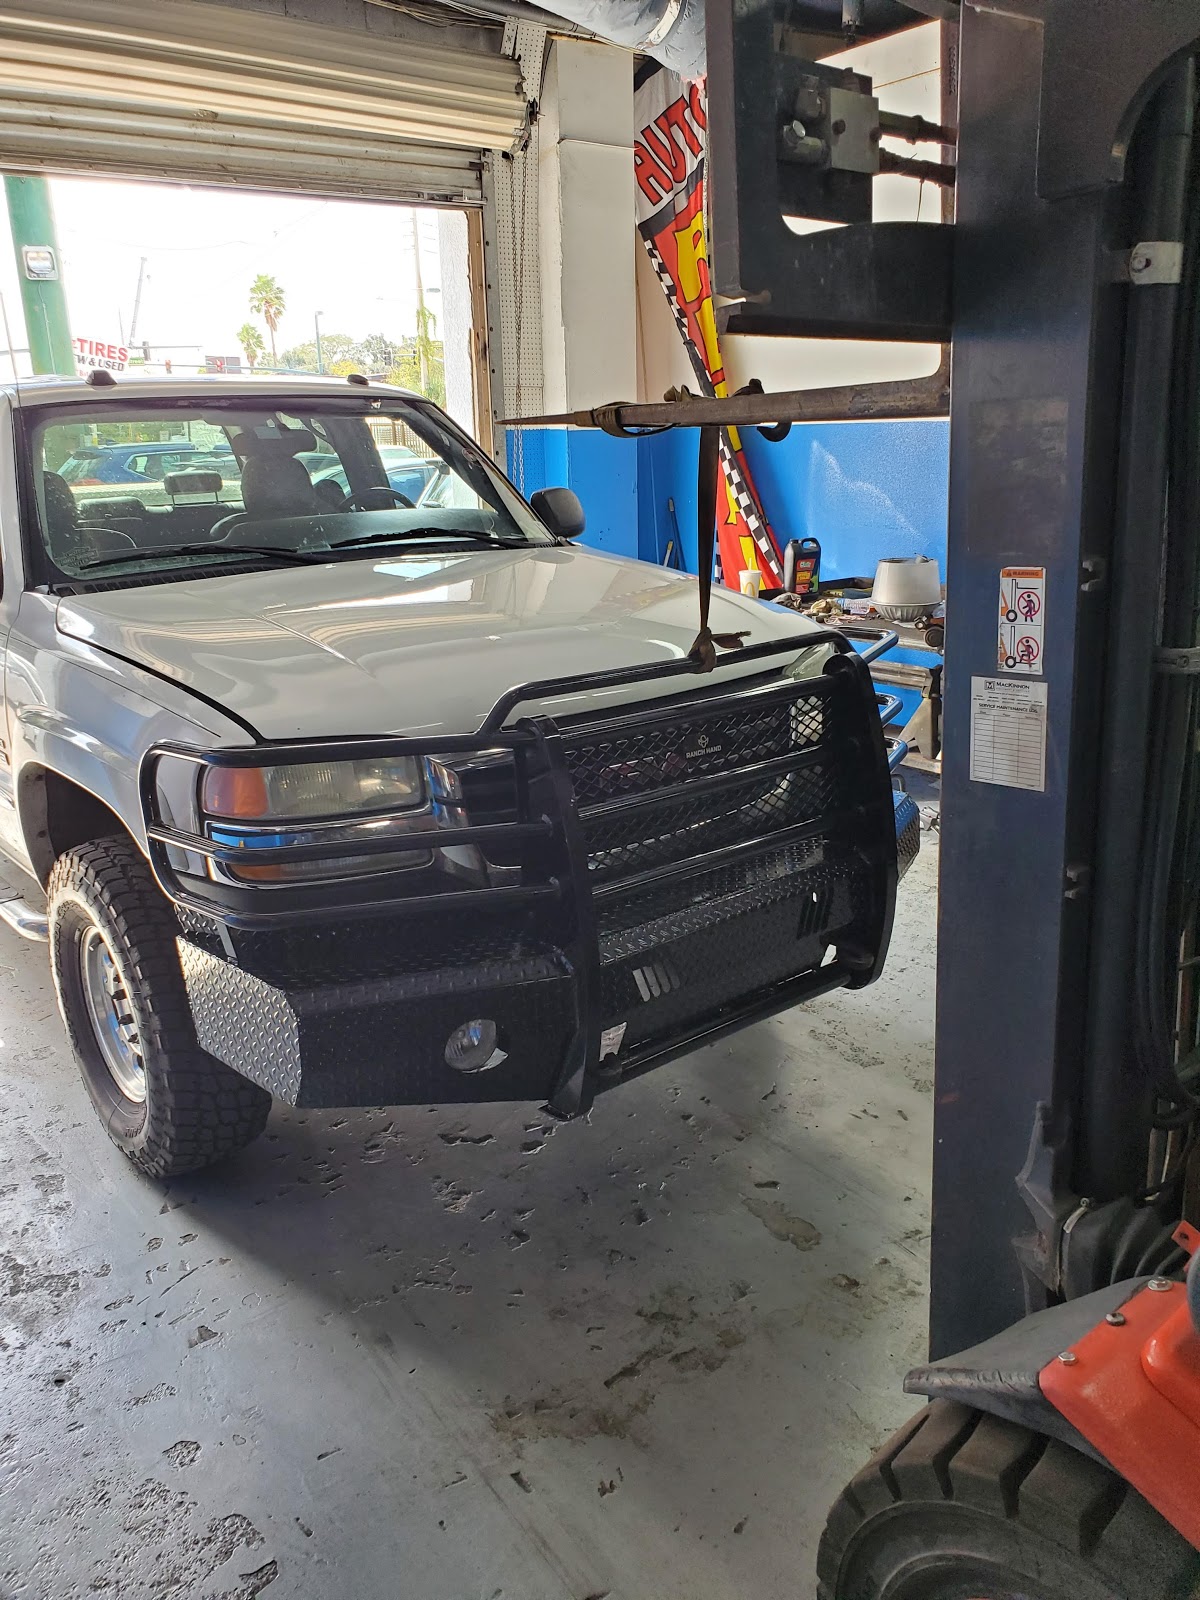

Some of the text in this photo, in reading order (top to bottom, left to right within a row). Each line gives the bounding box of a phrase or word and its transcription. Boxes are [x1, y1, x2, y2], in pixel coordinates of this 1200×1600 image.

[77, 338, 128, 362] TIRES
[89, 358, 97, 366] &
[98, 359, 124, 371] USED
[686, 745, 722, 759] RANCH HAND
